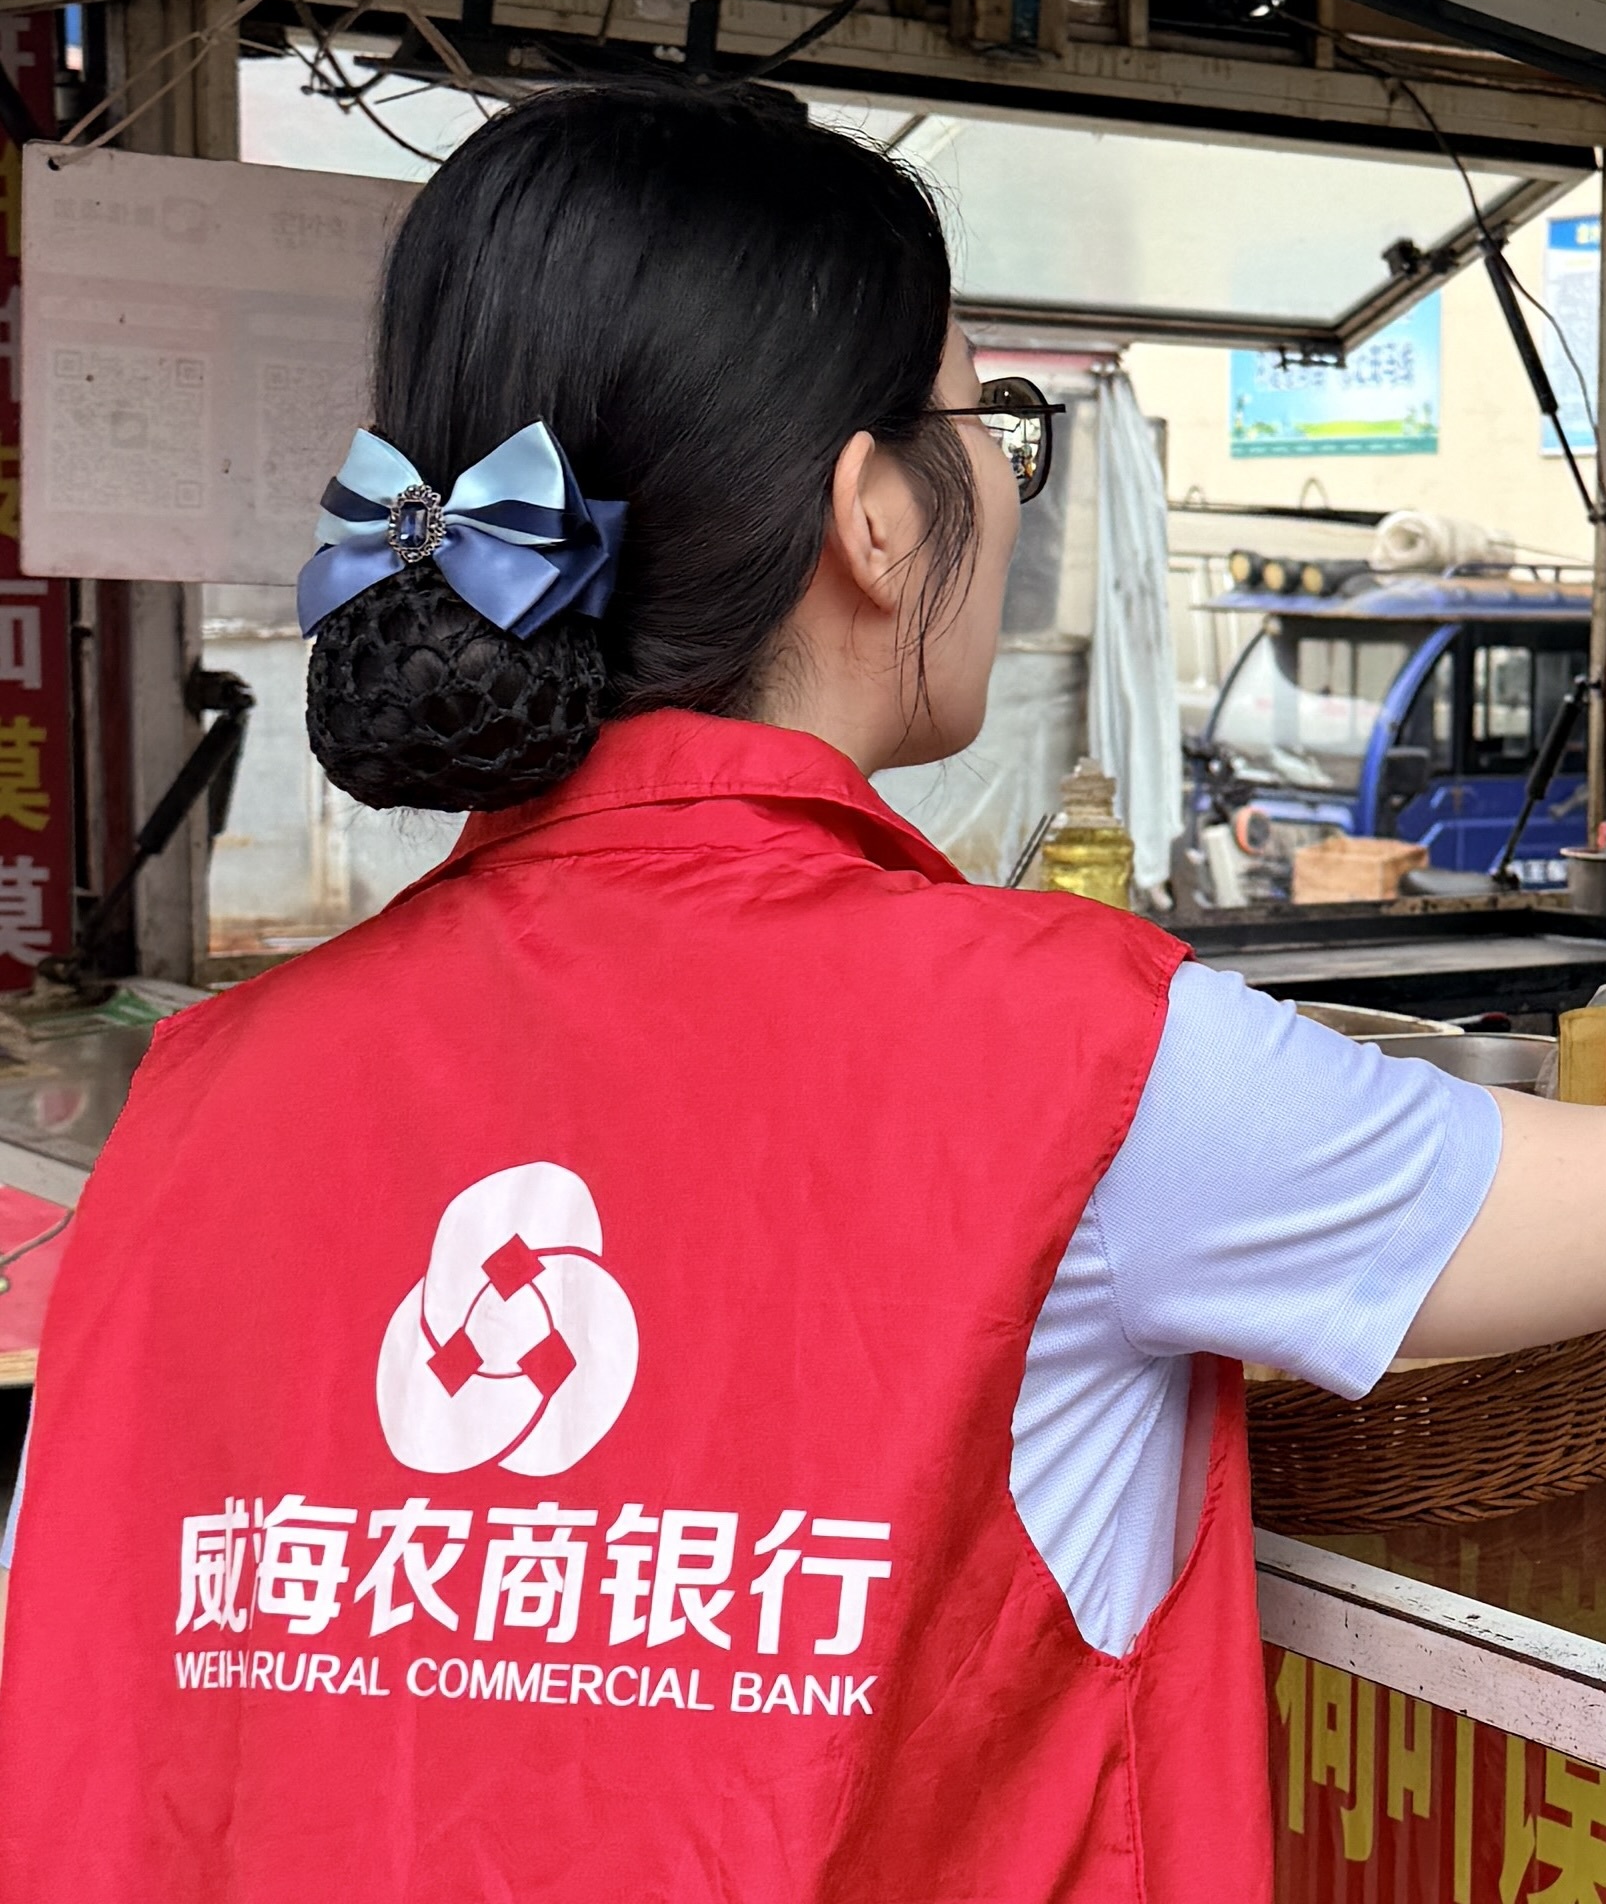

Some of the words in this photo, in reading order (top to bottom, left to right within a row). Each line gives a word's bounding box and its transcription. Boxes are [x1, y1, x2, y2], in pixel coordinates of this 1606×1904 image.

[175, 1493, 893, 1657] 威海农商银行
[405, 1656, 715, 1712] COMMERCIAL
[730, 1670, 879, 1717] BANK
